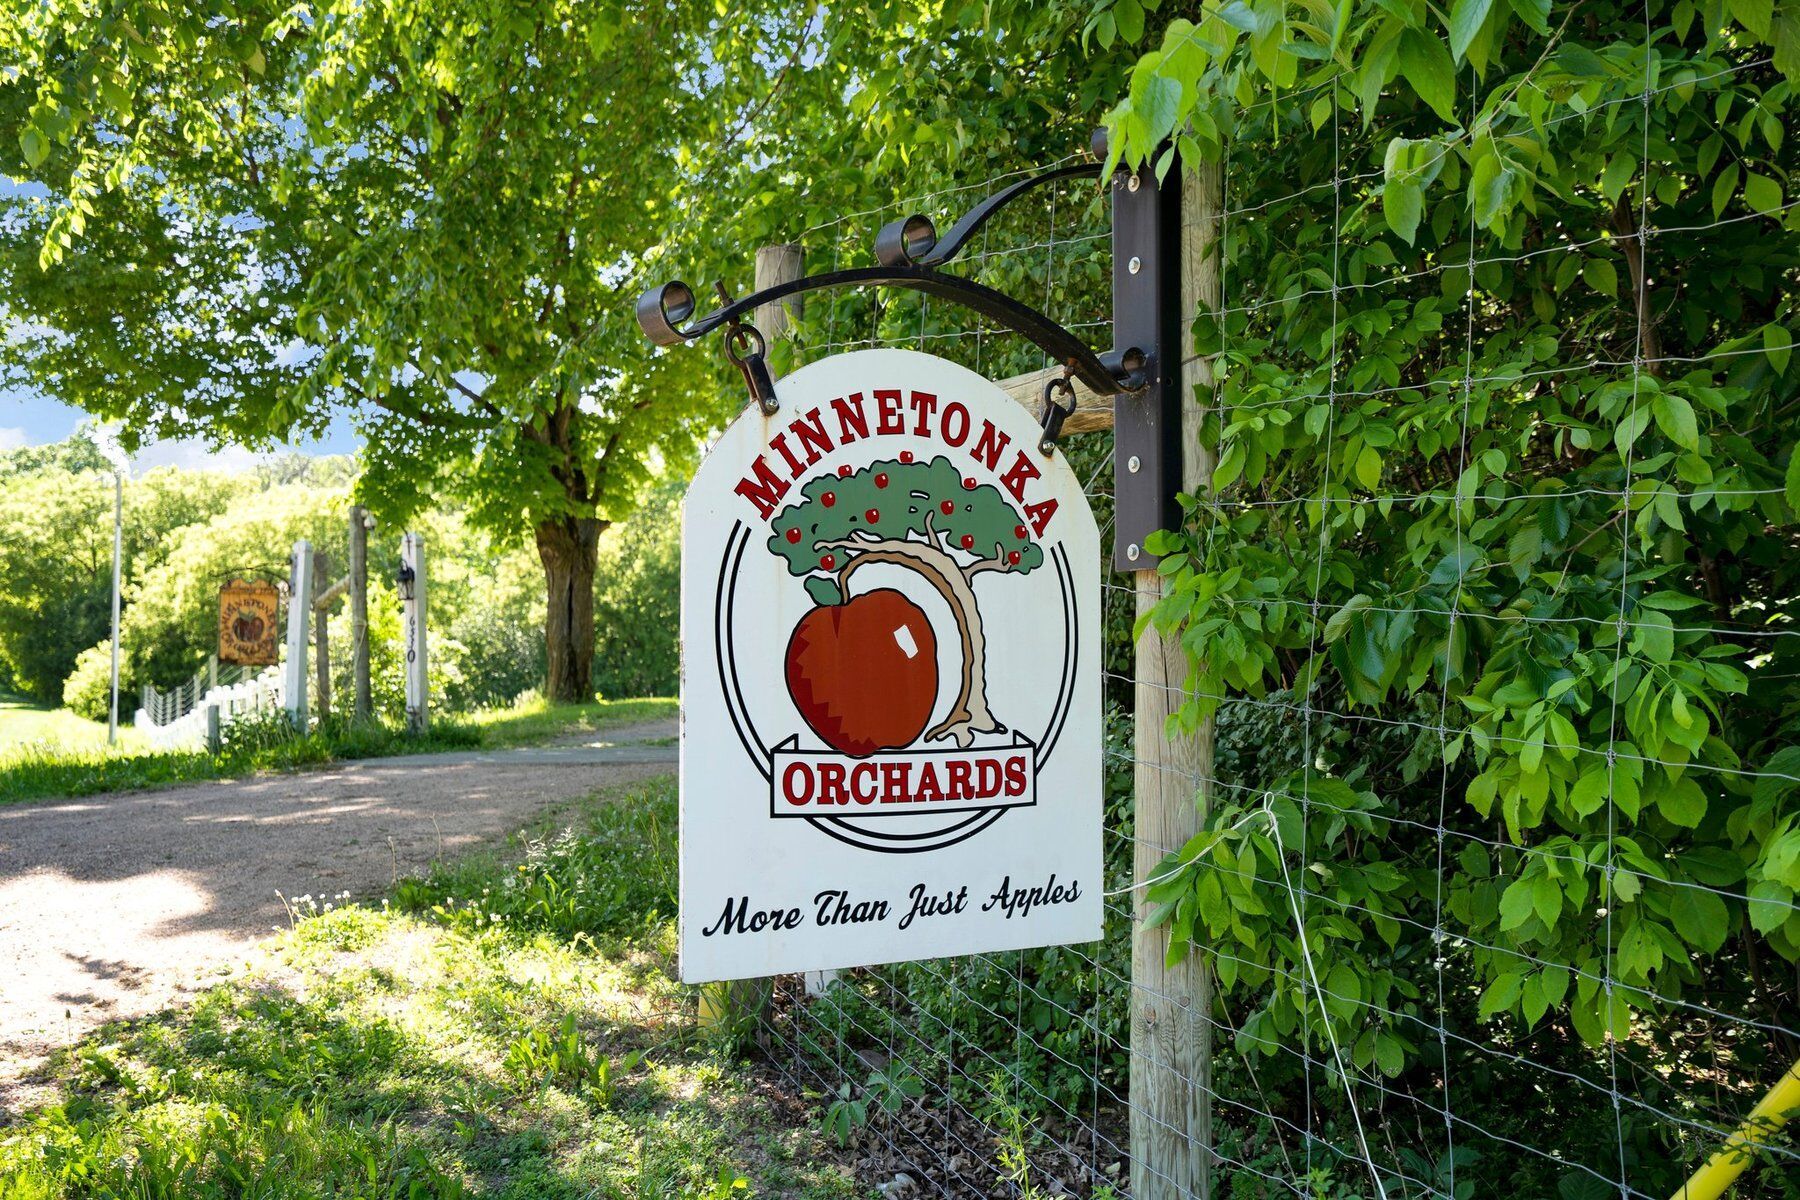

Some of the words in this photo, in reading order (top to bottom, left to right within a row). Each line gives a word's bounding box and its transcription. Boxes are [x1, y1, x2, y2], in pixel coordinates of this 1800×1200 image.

[733, 389, 1060, 538] MINNETONKA
[782, 756, 1027, 806] ORCHARDS
[702, 896, 804, 937] More
[814, 890, 891, 926] Than
[898, 883, 969, 930] Just
[981, 873, 1082, 919] Apples
